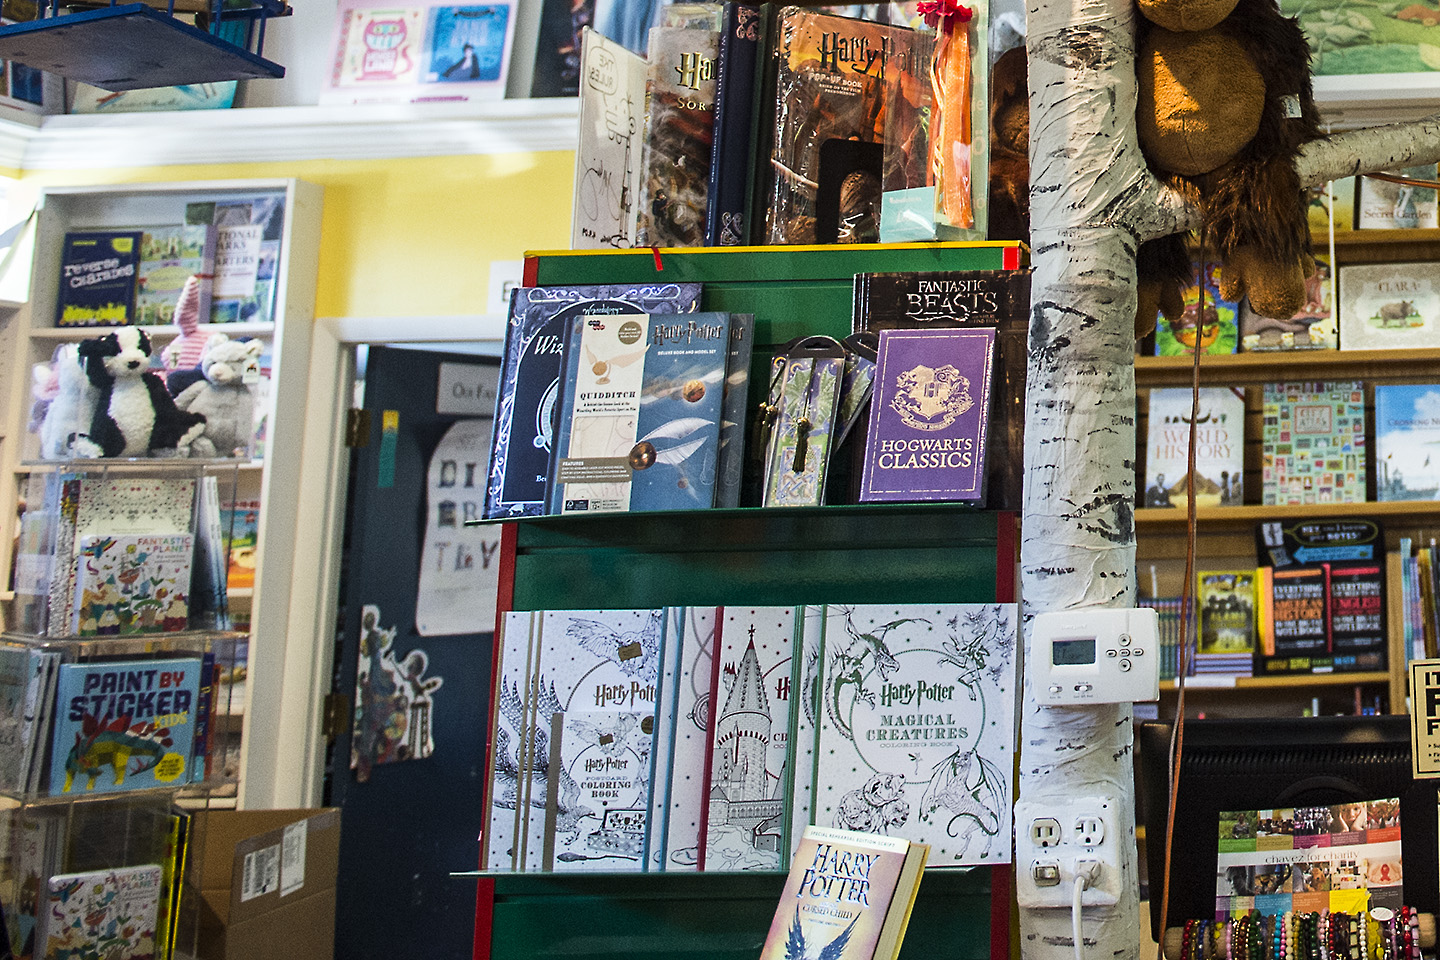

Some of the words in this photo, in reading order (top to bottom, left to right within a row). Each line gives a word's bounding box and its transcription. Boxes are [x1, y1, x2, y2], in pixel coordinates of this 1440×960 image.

[816, 31, 877, 74] Harry
[842, 80, 863, 88] BOOK
[1364, 209, 1393, 219] Secret
[1396, 209, 1432, 220] Garden
[918, 280, 988, 293] FANTASTIC
[906, 291, 999, 318] BEASTS
[652, 325, 685, 345] Harry
[684, 321, 723, 344] Potter
[580, 391, 637, 400] QUIDDITCH
[1388, 417, 1430, 427] CROSSING
[881, 438, 972, 452] HOGWARTS
[879, 452, 972, 469] CLASSICS
[137, 537, 191, 546] FANTASTIC
[152, 545, 191, 553] PLANET
[1274, 584, 1323, 593] EVERYTHING
[1332, 582, 1381, 591] EVERYTHING
[1275, 609, 1323, 621] HISTORY
[1275, 627, 1324, 637] NOTEBOOK
[1333, 623, 1381, 632] NOTEBOOK
[84, 670, 157, 694] PAINT
[159, 671, 185, 688] BY
[593, 684, 629, 708] Harry
[880, 683, 916, 707] Harry
[916, 680, 955, 711] Potter
[69, 690, 192, 722] STICKER
[154, 710, 188, 729] KIDS
[880, 713, 956, 727] MAGICAL
[865, 727, 969, 741] CREATURES
[584, 758, 607, 772] Harry
[606, 757, 628, 775] Potter
[580, 780, 631, 789] COLORING
[591, 790, 619, 798] BOOK
[856, 837, 877, 845] EDITION
[877, 840, 896, 848] SCRIPT
[811, 843, 881, 881] HARRY
[1264, 854, 1306, 865] chavez
[1306, 851, 1321, 861] for
[1323, 849, 1360, 861] charity
[796, 868, 870, 908] POTTER
[802, 904, 829, 915] CURSED
[829, 908, 853, 920] CHILD
